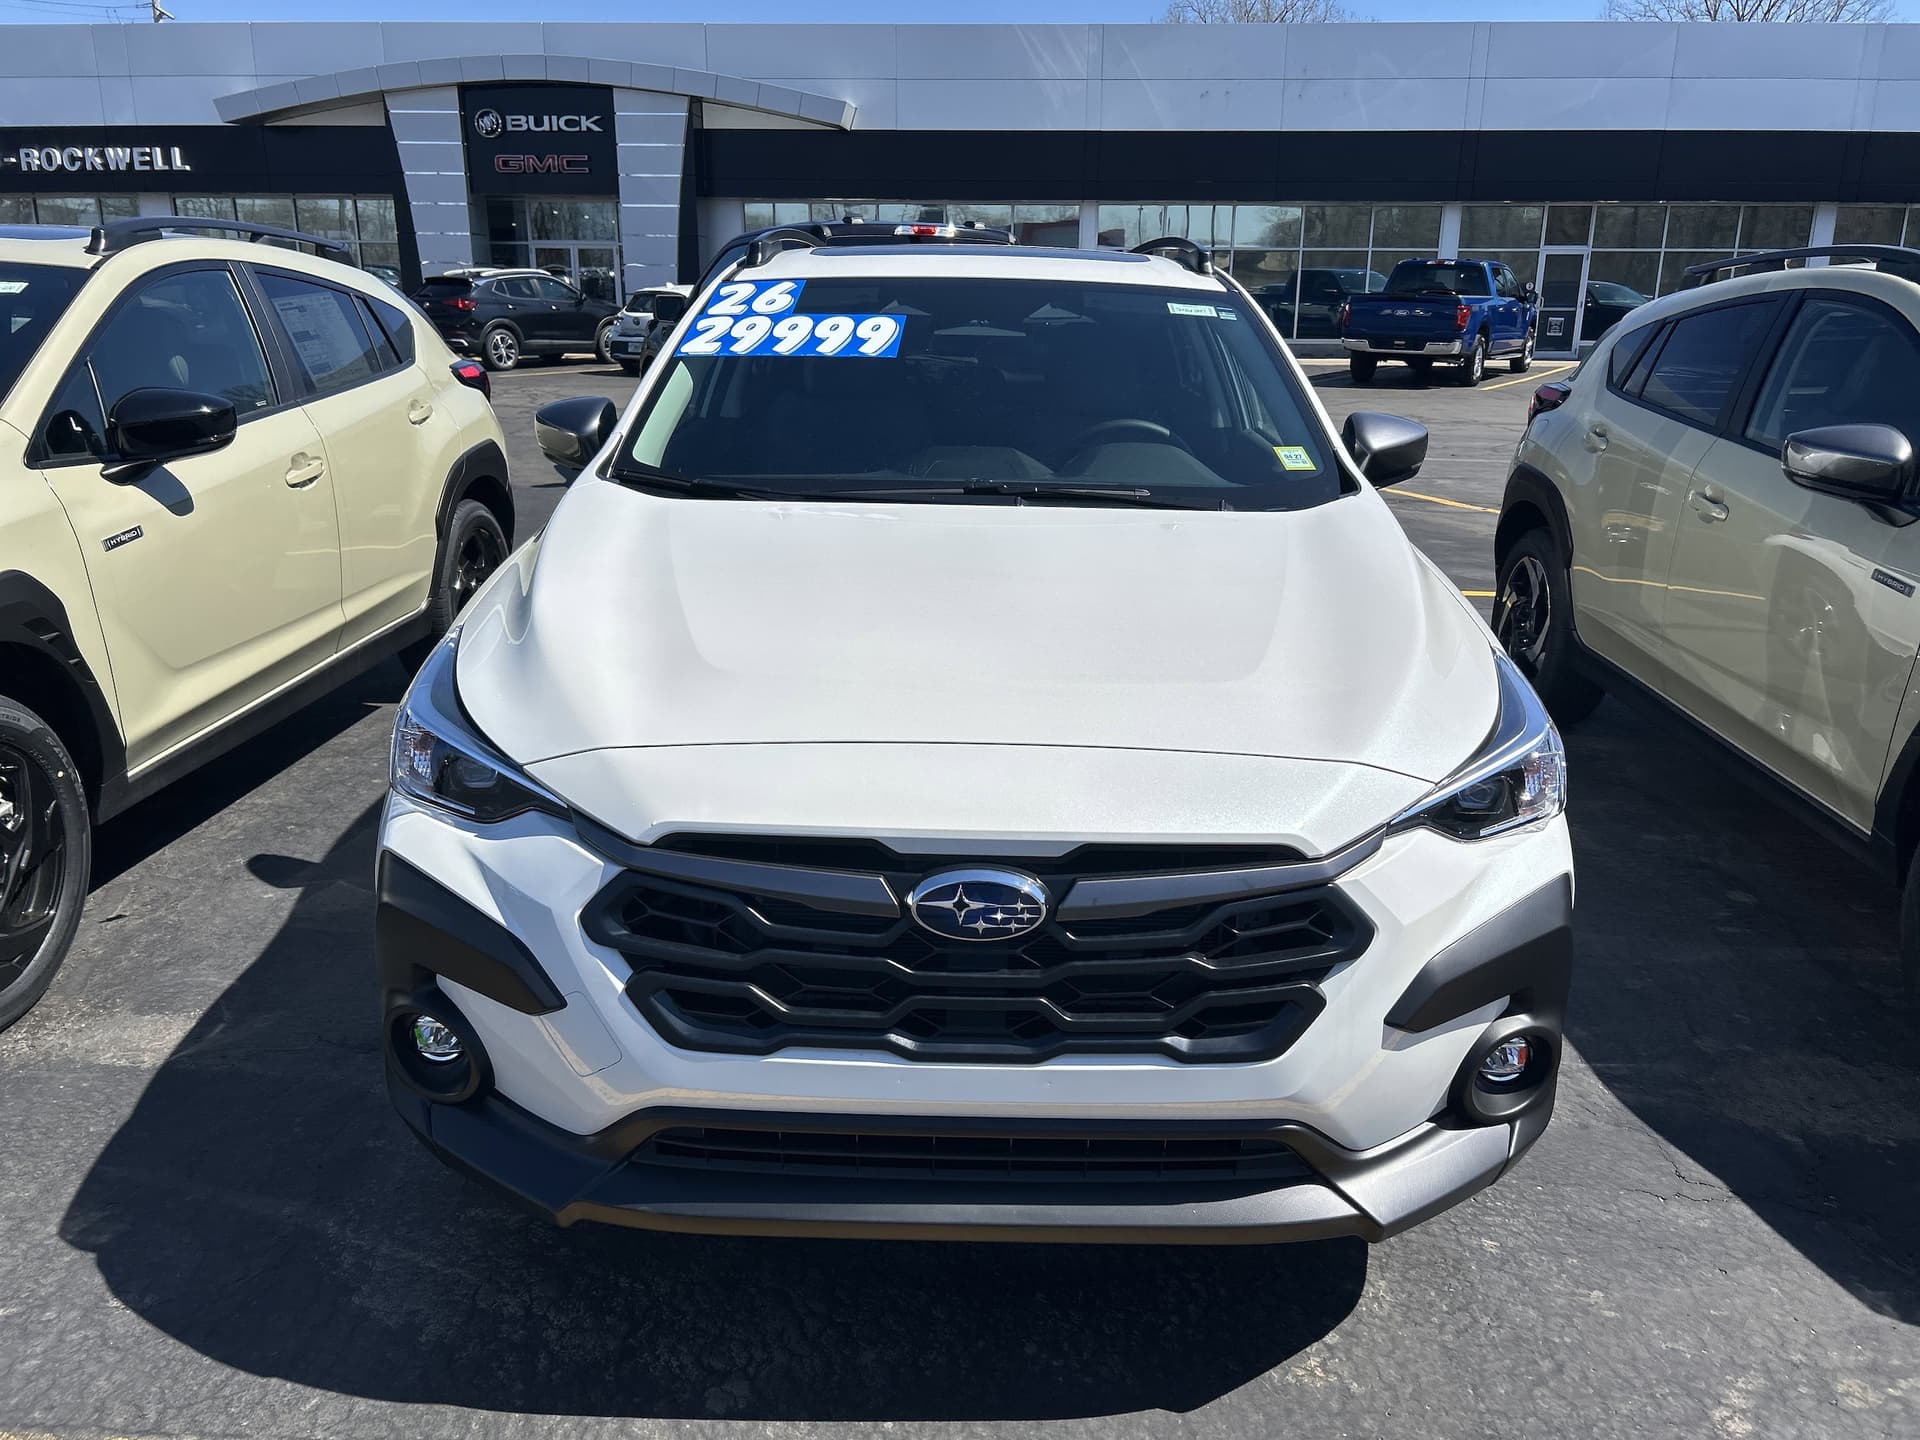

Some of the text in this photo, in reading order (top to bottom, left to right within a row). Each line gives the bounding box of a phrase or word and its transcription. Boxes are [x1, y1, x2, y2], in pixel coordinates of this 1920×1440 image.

[505, 114, 604, 132] BUICK
[494, 154, 590, 174] GMC
[707, 281, 798, 316] 26
[680, 315, 900, 355] 29999
[110, 530, 138, 546] HYBRID
[1878, 574, 1905, 591] HYBRID
